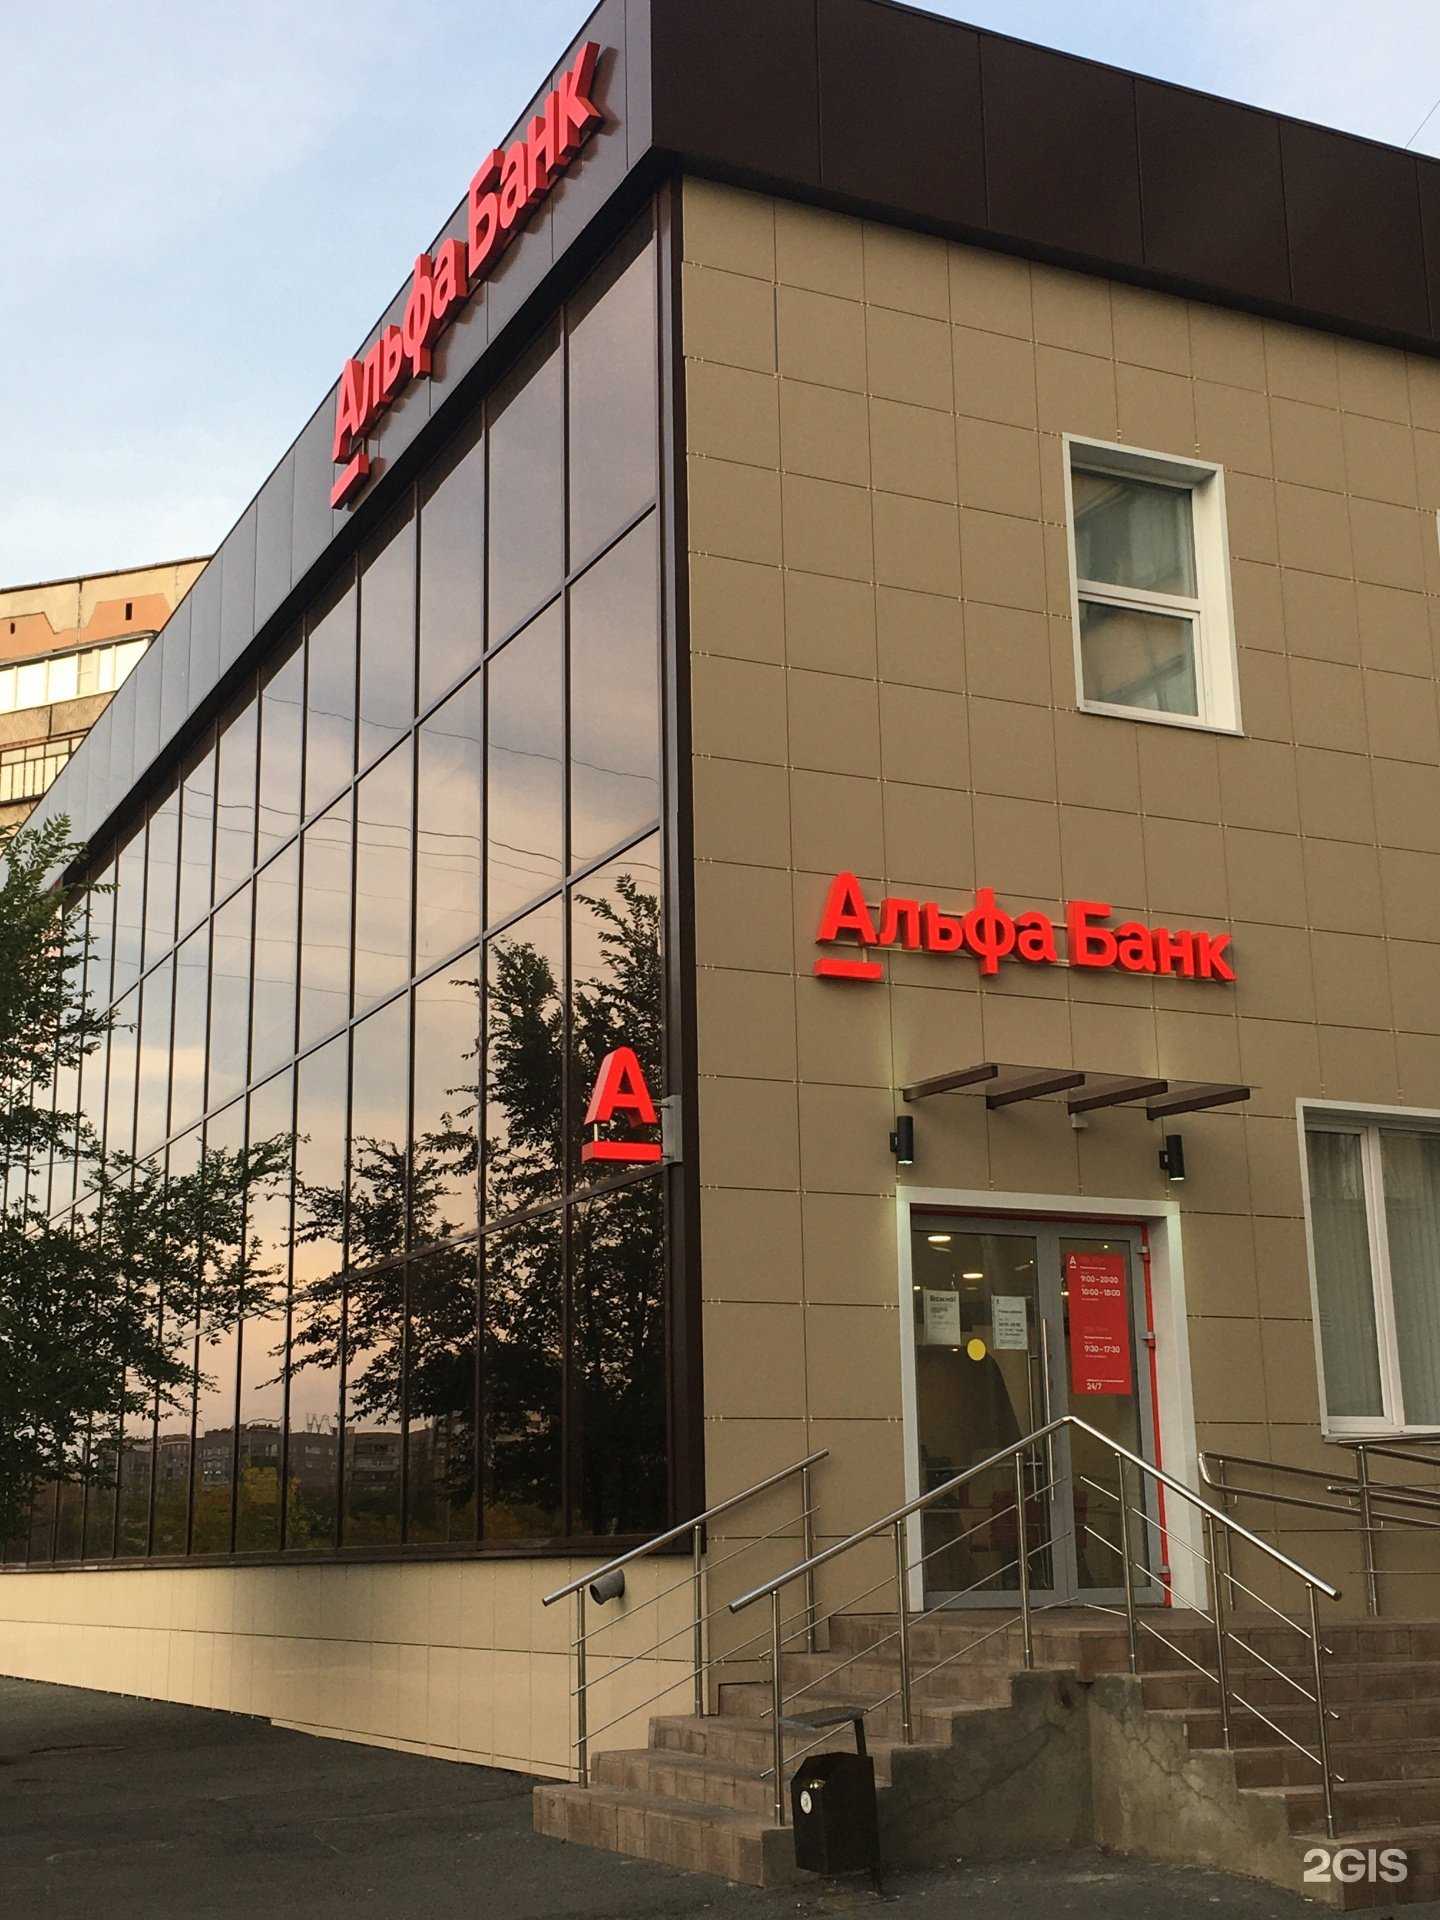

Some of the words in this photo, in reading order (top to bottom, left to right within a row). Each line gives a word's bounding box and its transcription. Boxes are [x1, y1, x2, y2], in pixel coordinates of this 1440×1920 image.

[332, 238, 468, 464] Альфа
[468, 41, 601, 279] Банк
[815, 871, 1057, 976] Альфа
[1067, 900, 1237, 982] Банк
